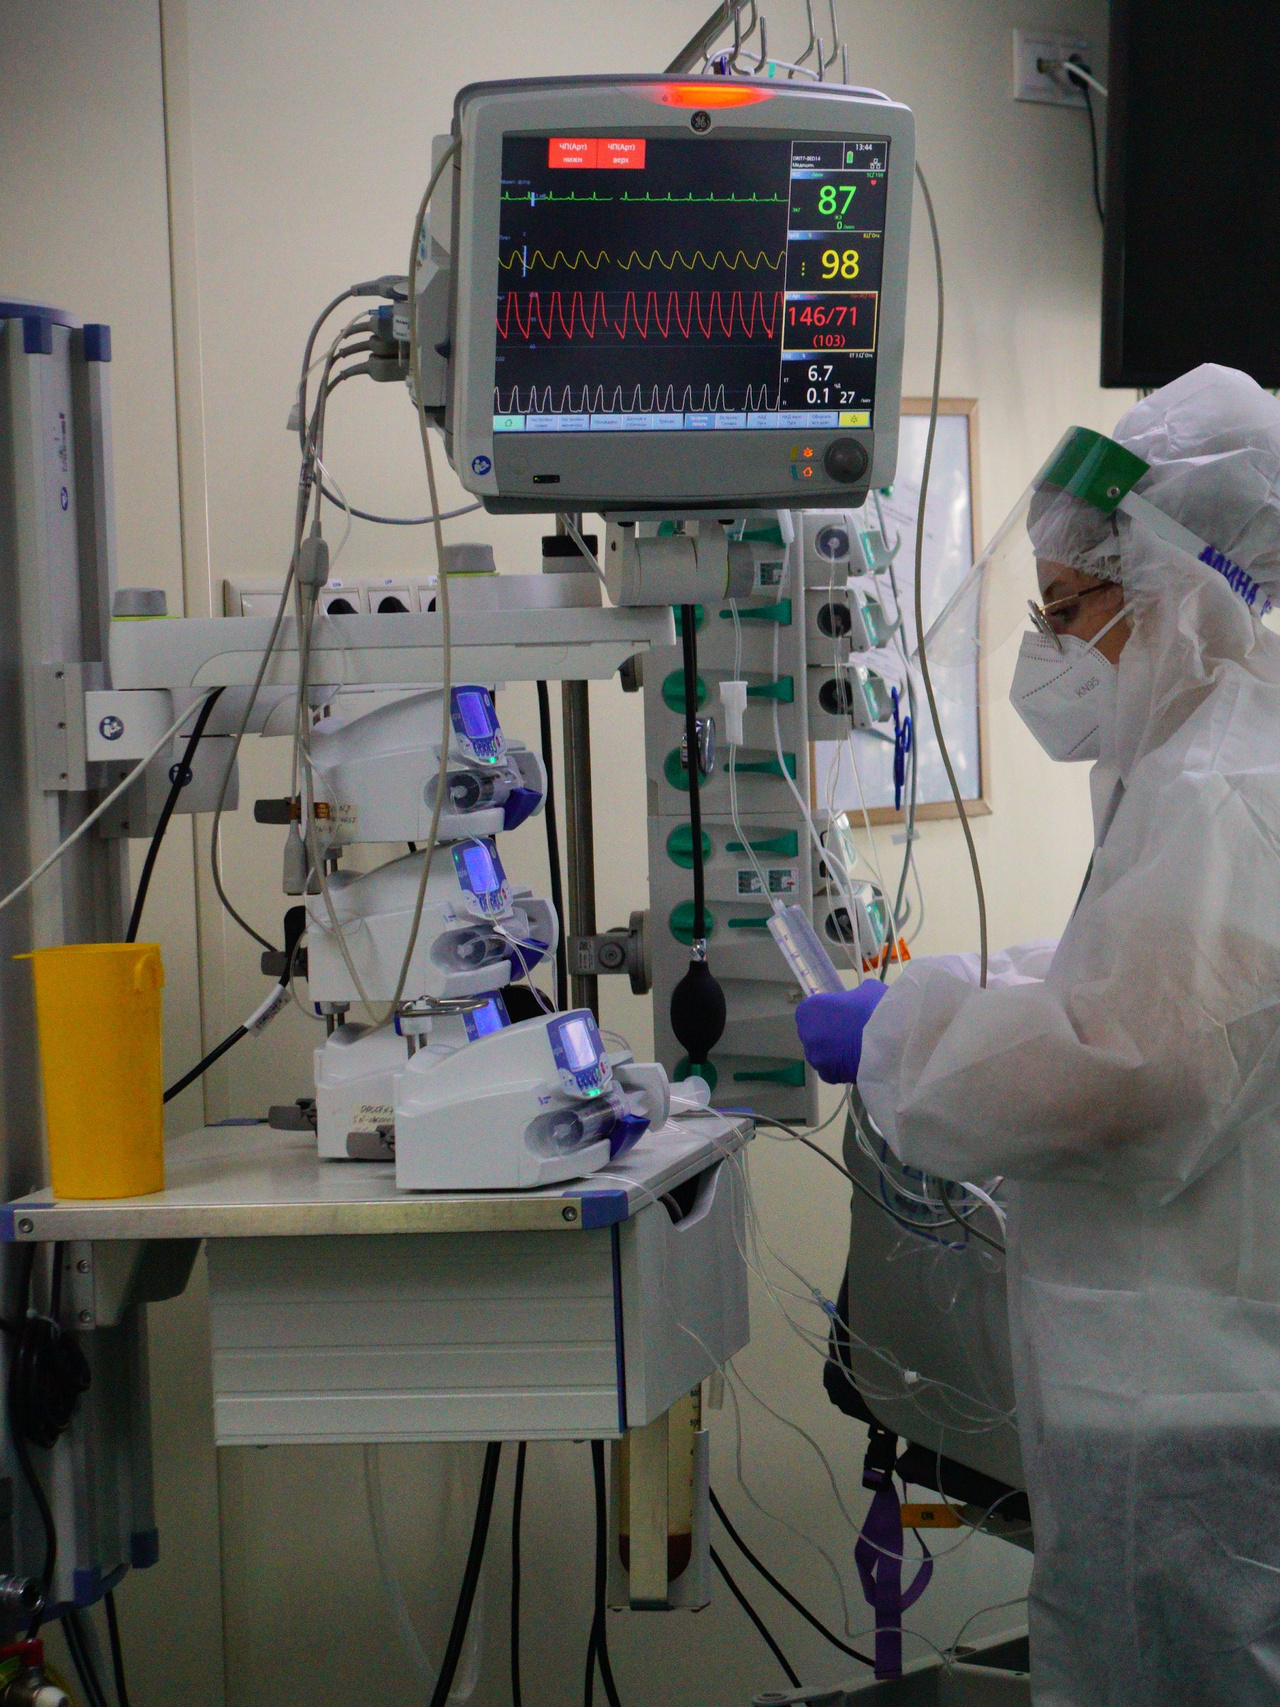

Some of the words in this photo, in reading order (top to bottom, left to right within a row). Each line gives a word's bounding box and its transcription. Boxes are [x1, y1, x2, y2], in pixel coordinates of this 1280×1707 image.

[559, 143, 588, 152] ЧП(Арт)
[607, 143, 636, 152] ЧП(Арт)
[613, 157, 629, 165] верх
[818, 185, 857, 215] 87
[836, 221, 843, 230] 0
[821, 249, 859, 279] 98
[788, 306, 857, 326] 146/71
[812, 334, 846, 348] (103)
[808, 365, 833, 381] 6.7
[806, 387, 829, 404] 0.1
[839, 391, 855, 404] 27
[1075, 676, 1100, 699] KN95
